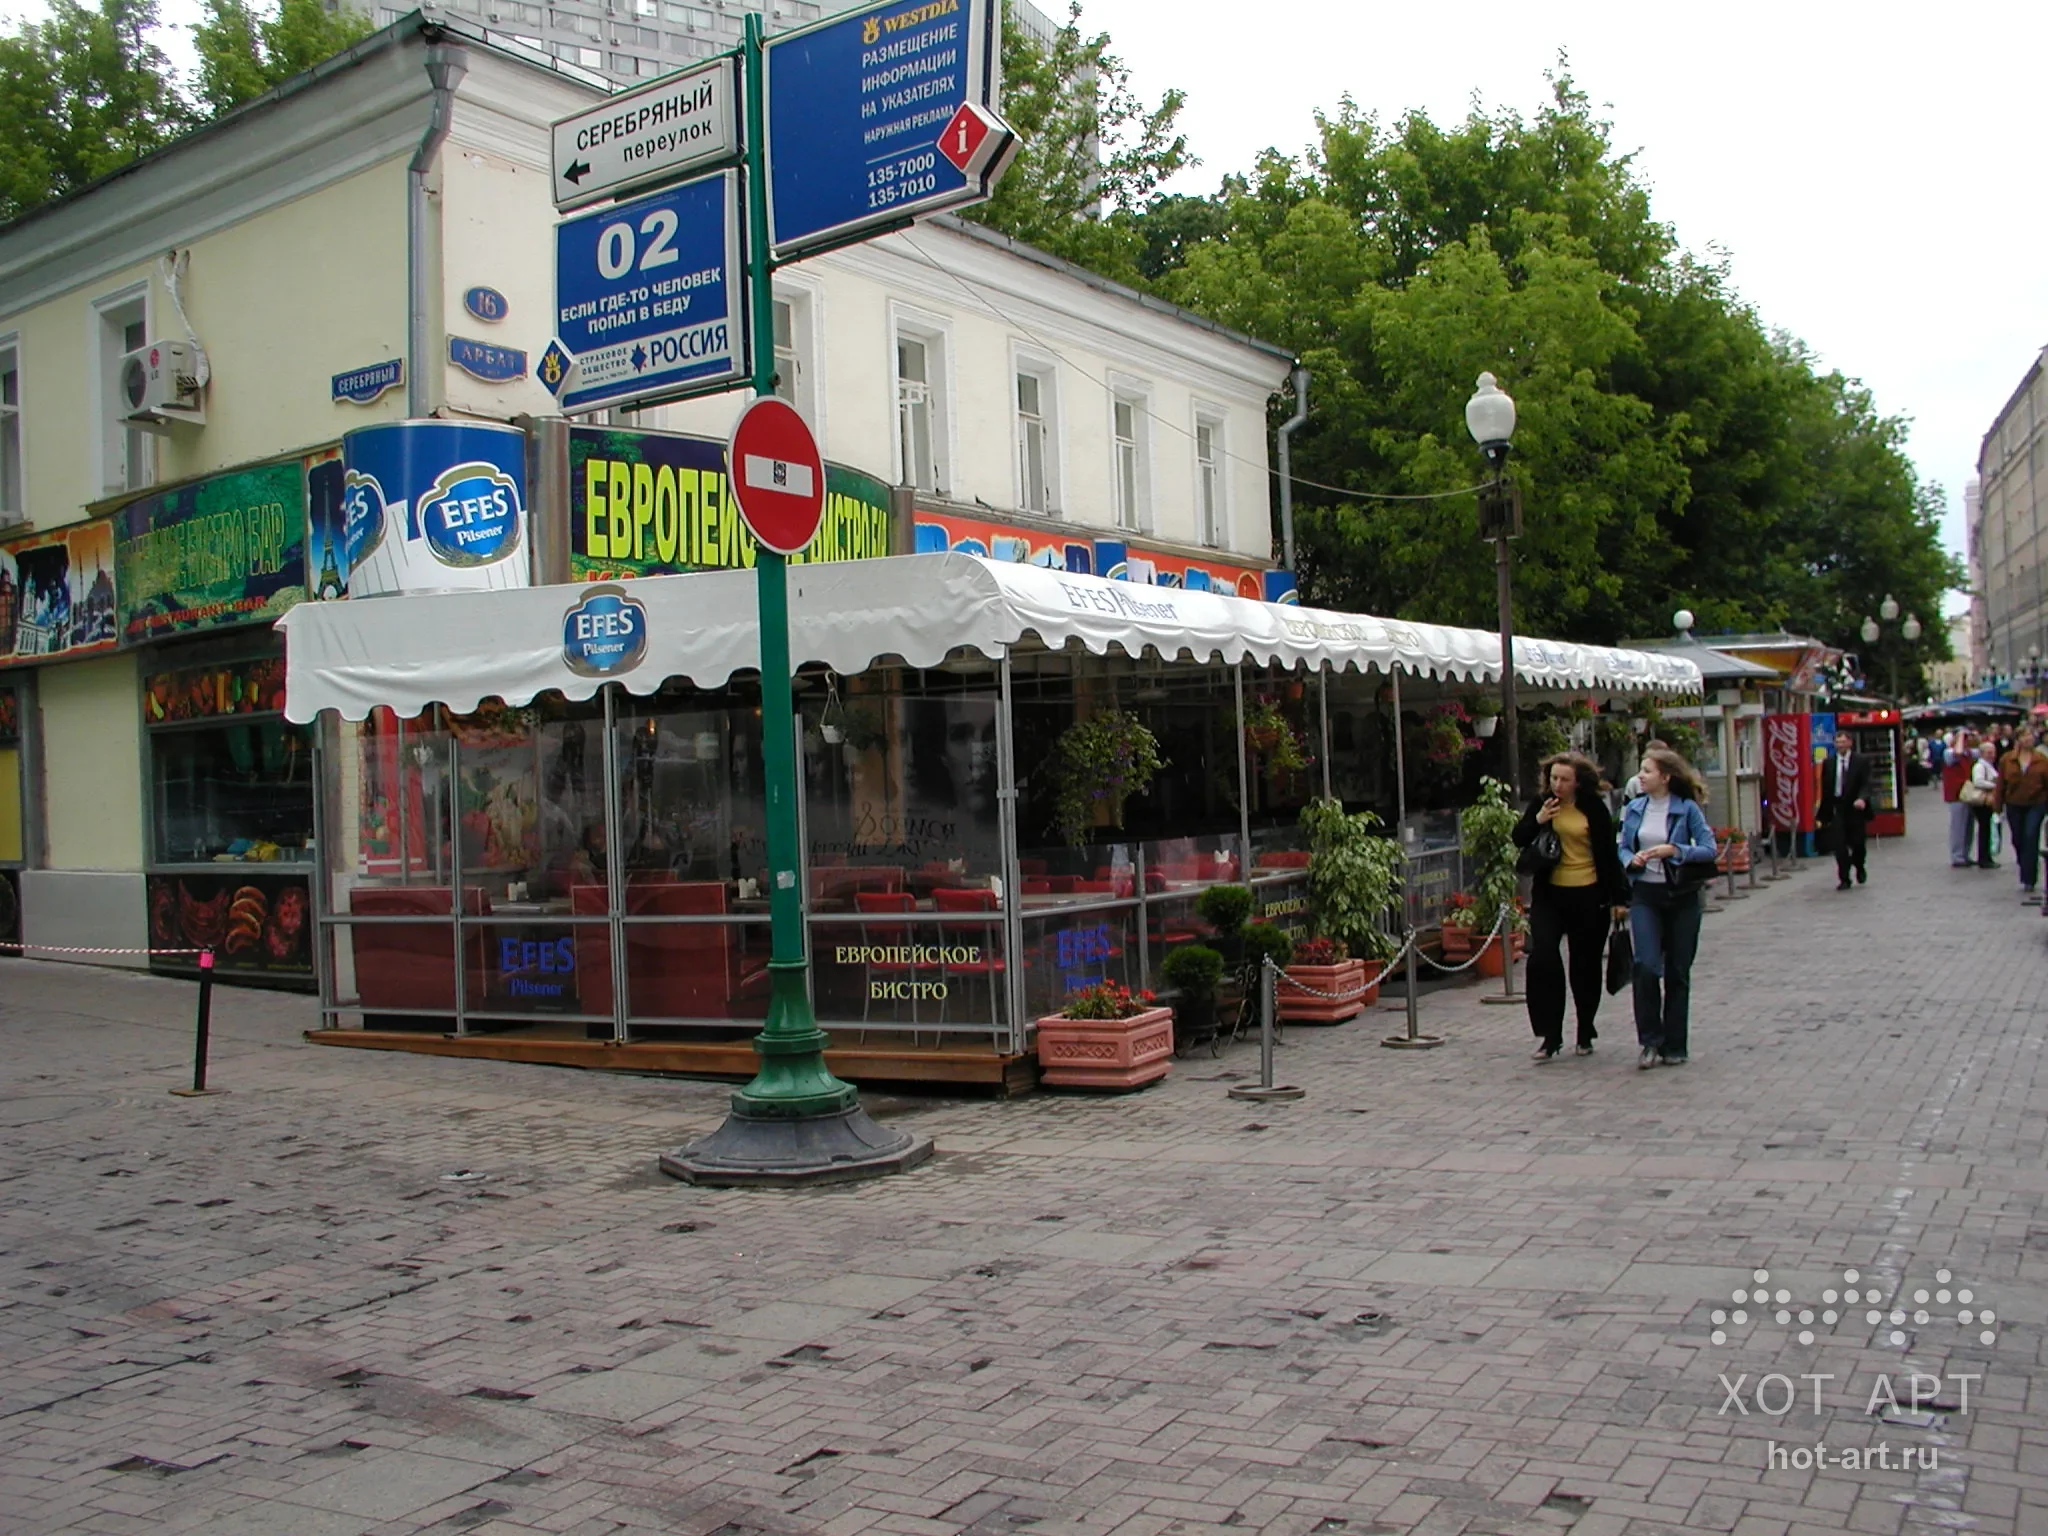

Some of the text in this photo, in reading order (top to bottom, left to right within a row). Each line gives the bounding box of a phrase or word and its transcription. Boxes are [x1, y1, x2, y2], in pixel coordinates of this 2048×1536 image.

[884, 0, 959, 33] WESTDIA
[862, 23, 958, 69] РАЗМЕЩЕНИЕ
[862, 48, 957, 94] ИНФОРМАЦИИ
[861, 74, 956, 119] НА УКАЗАТЕЛЯХ
[577, 79, 713, 151] СЕРЕБРЯНЫЙ
[864, 103, 954, 145] НАРУЖНАЯ РЕКЛАМА
[623, 120, 712, 162] переулок
[597, 208, 679, 280] 02
[477, 291, 498, 316] 16
[561, 267, 722, 323] ЕСЛИ ГДЕ-ТО ЧЕЛОВЕК
[588, 295, 692, 335] ПОПАЛ В БЕДУ
[462, 345, 517, 370] АРБАТ
[580, 348, 628, 365] СТРАХОВОЕ
[651, 324, 729, 367] РОССИЯ
[338, 364, 396, 393] СЕРЕБРЯНЫЙ
[582, 359, 627, 376] ОБЩЕСТВО
[439, 489, 510, 530] EFES
[456, 525, 504, 546] Pilsener
[1059, 582, 1117, 614] EFES
[576, 608, 634, 640] EFES
[583, 642, 625, 657] Pilsener
[1769, 719, 1800, 829] Coca-Cola
[501, 936, 575, 973] EFES
[835, 943, 981, 964] ЕВРОПЕЙСКОЕ
[510, 977, 564, 997] Pilsener
[870, 981, 948, 1000] БИСТРО
